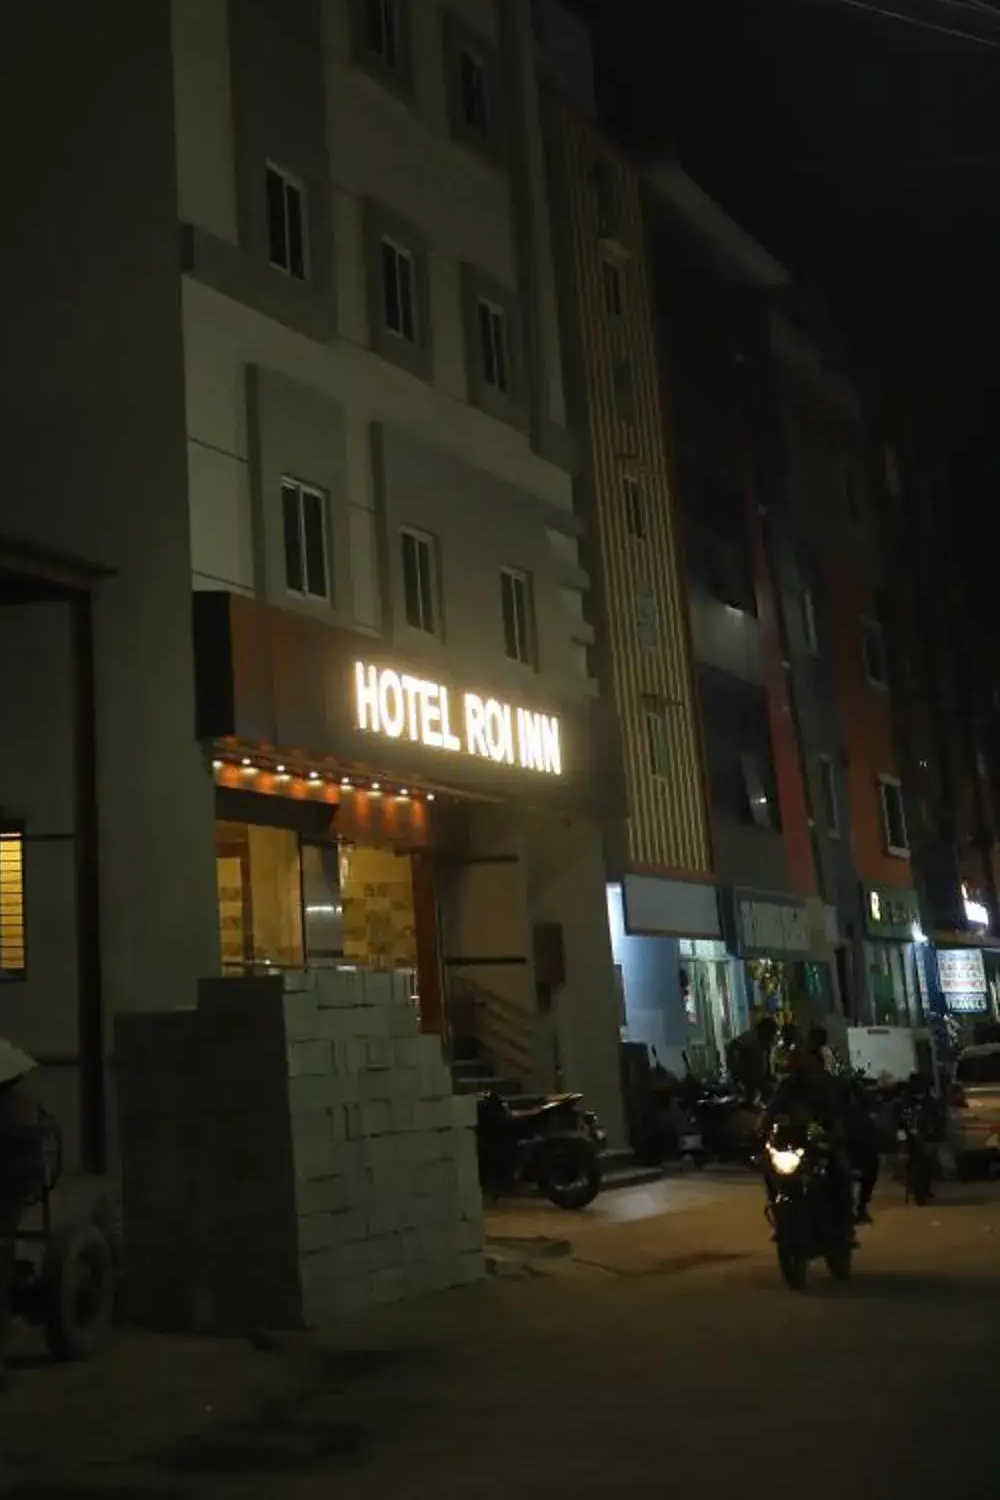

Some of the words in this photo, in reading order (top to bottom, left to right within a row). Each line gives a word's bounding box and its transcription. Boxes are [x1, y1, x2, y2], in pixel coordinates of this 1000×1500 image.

[355, 661, 461, 751] HOTEL
[463, 692, 515, 765] ROI
[516, 707, 562, 775] INN
